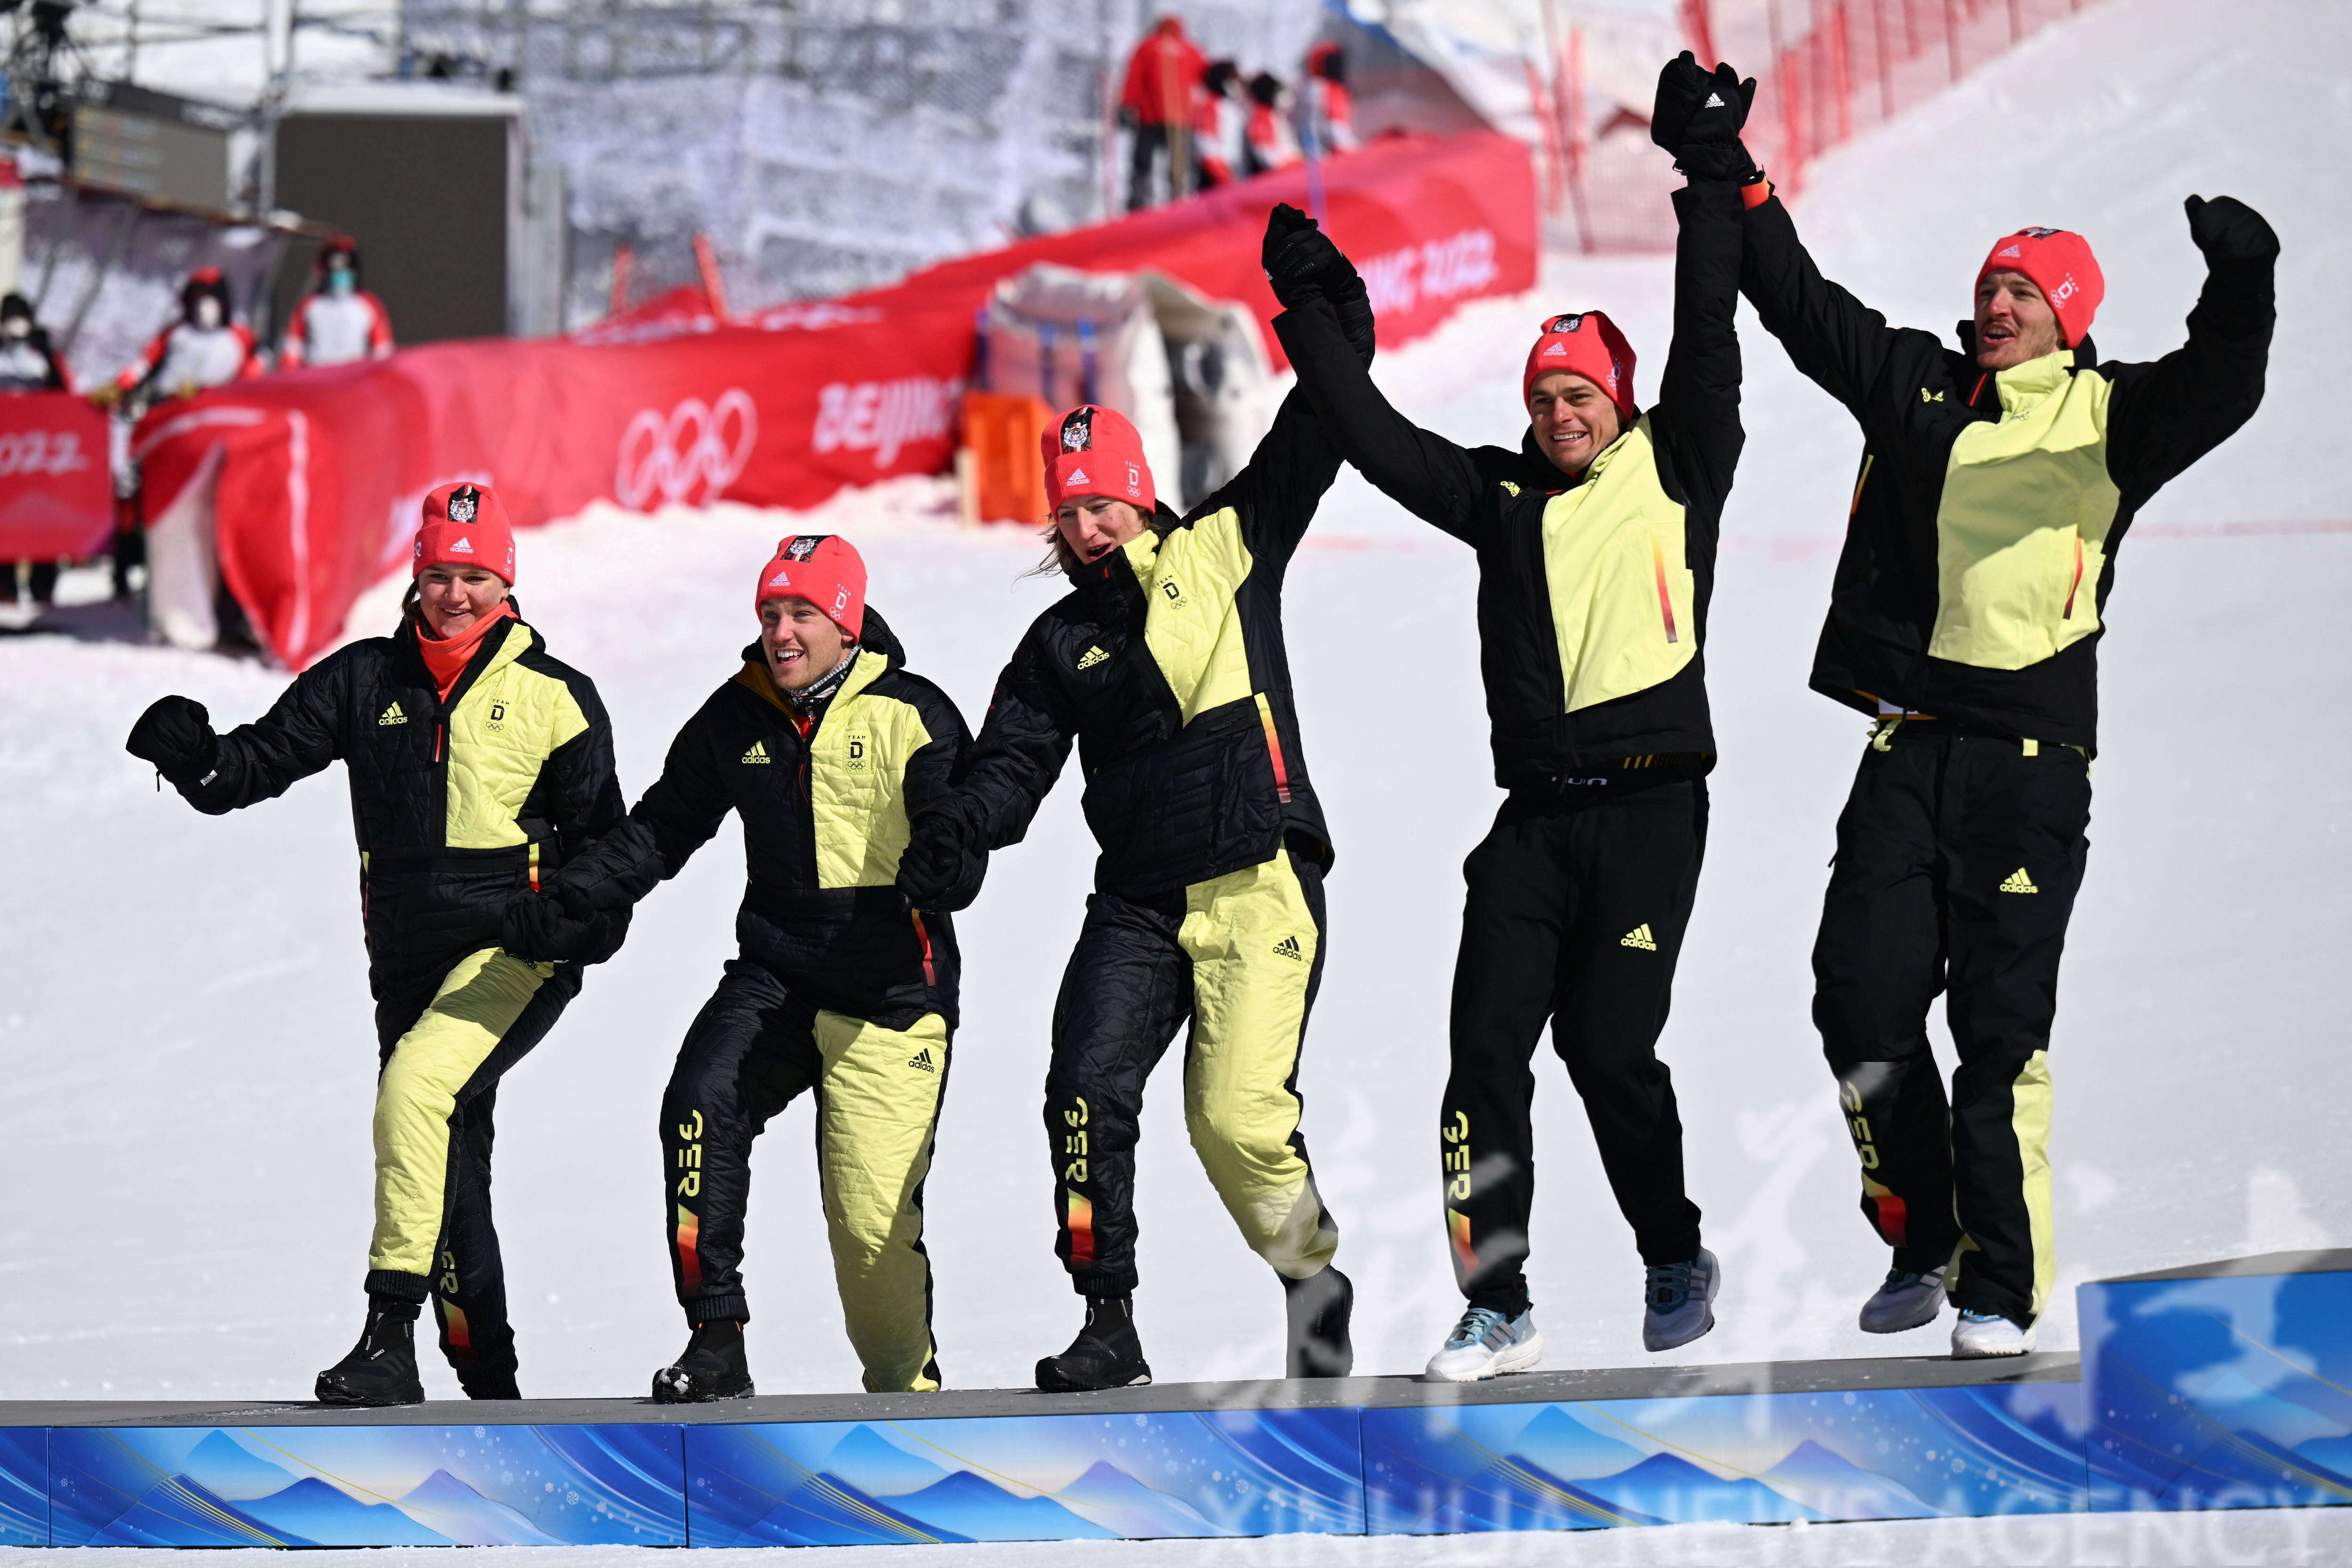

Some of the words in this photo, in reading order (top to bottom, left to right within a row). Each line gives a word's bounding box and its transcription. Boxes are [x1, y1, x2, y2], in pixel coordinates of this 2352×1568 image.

[1156, 574, 1173, 586] TEAM
[1077, 652, 1109, 670] adidas
[378, 716, 408, 726] adidas
[742, 754, 771, 764] adidas
[2000, 883, 2038, 894] adidas
[1621, 938, 1657, 951] adidas
[1272, 947, 1302, 961] adidas
[908, 1060, 935, 1073] adidas
[1064, 1096, 1088, 1182] GER
[678, 1109, 703, 1196] GER
[1443, 1111, 1471, 1201] GER
